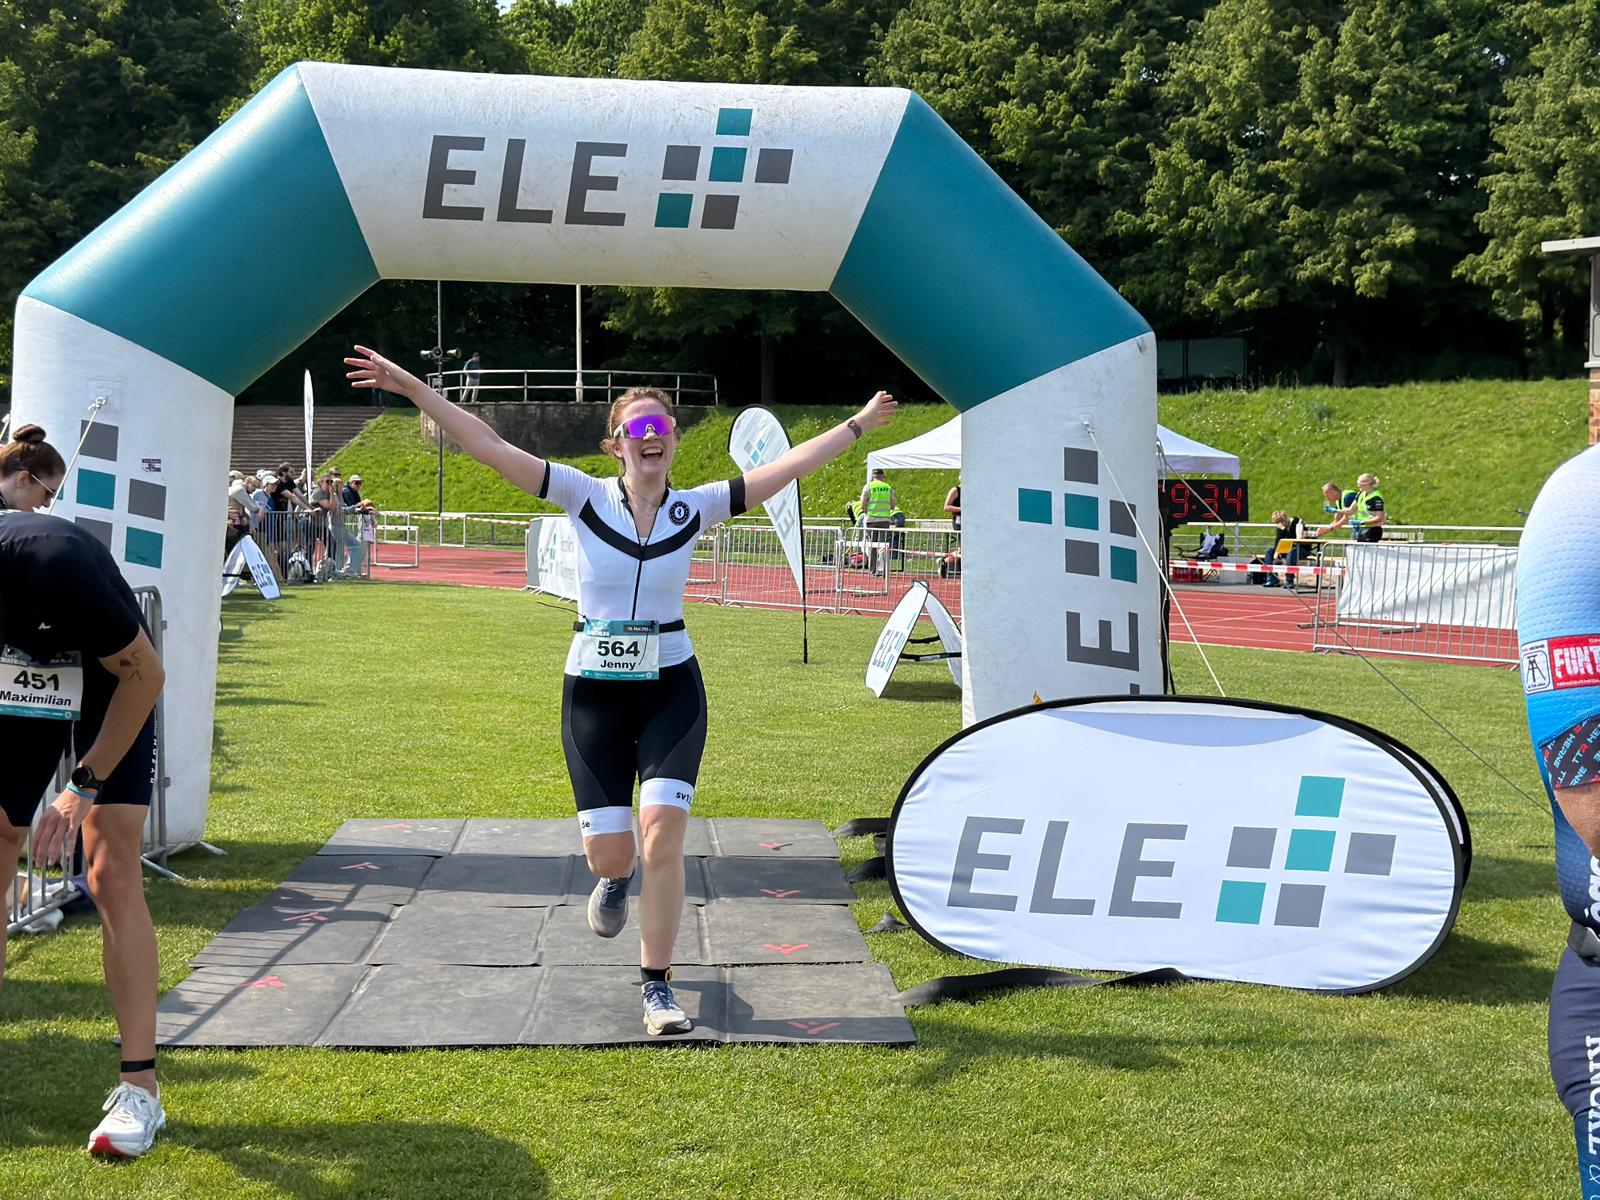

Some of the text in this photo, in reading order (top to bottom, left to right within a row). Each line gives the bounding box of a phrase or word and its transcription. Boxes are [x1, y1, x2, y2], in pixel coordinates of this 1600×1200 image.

[422, 135, 628, 226] ELE
[597, 640, 640, 657] 564
[600, 660, 636, 671] Jenny
[13, 670, 60, 691] 451
[0, 690, 72, 706] Maximilian
[947, 816, 1188, 919] ELE
